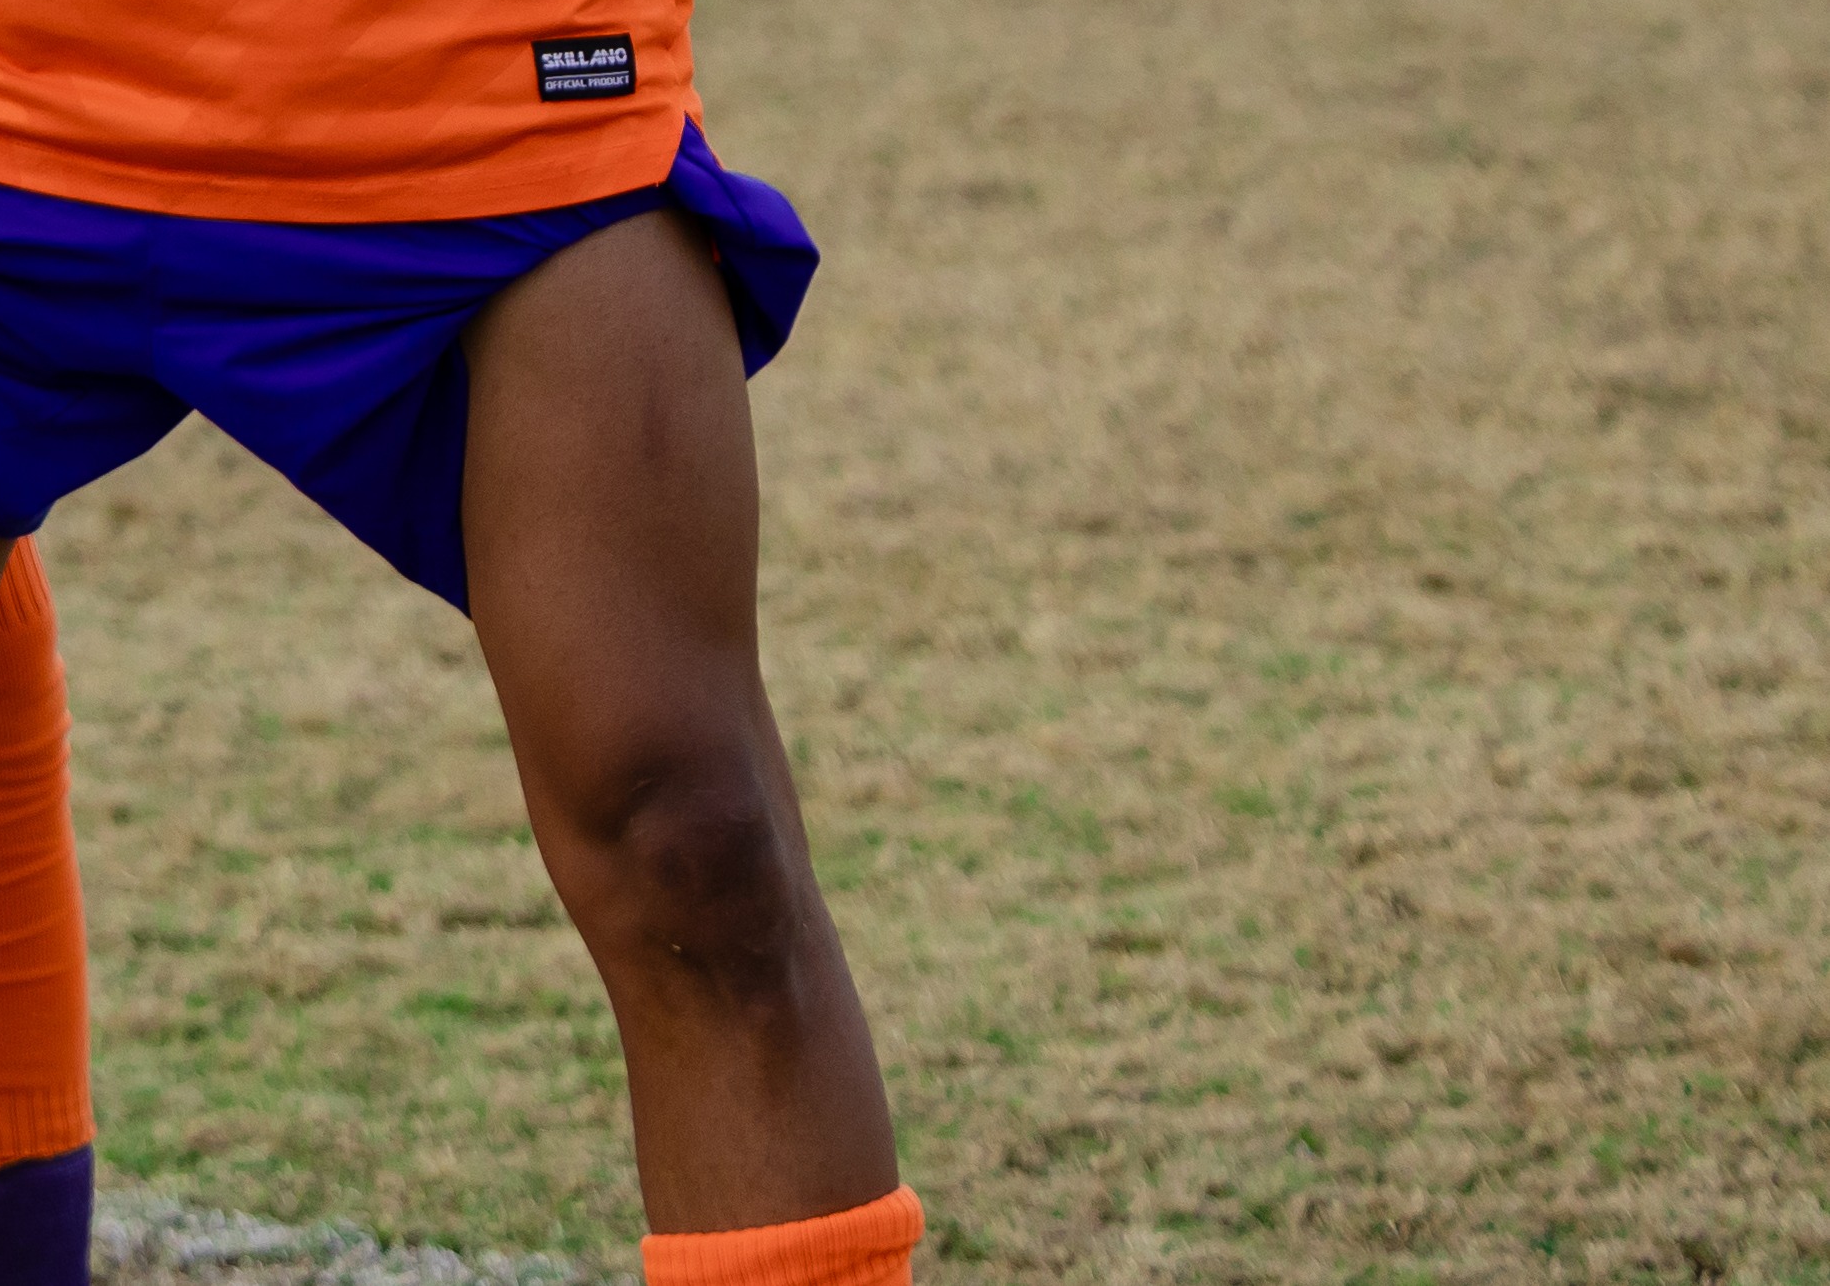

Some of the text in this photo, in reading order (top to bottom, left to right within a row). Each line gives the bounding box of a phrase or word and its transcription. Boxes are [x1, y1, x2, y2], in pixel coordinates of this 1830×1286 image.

[541, 47, 628, 70] SKILLANO
[545, 74, 630, 92] OFFICIAL PRODUCT
